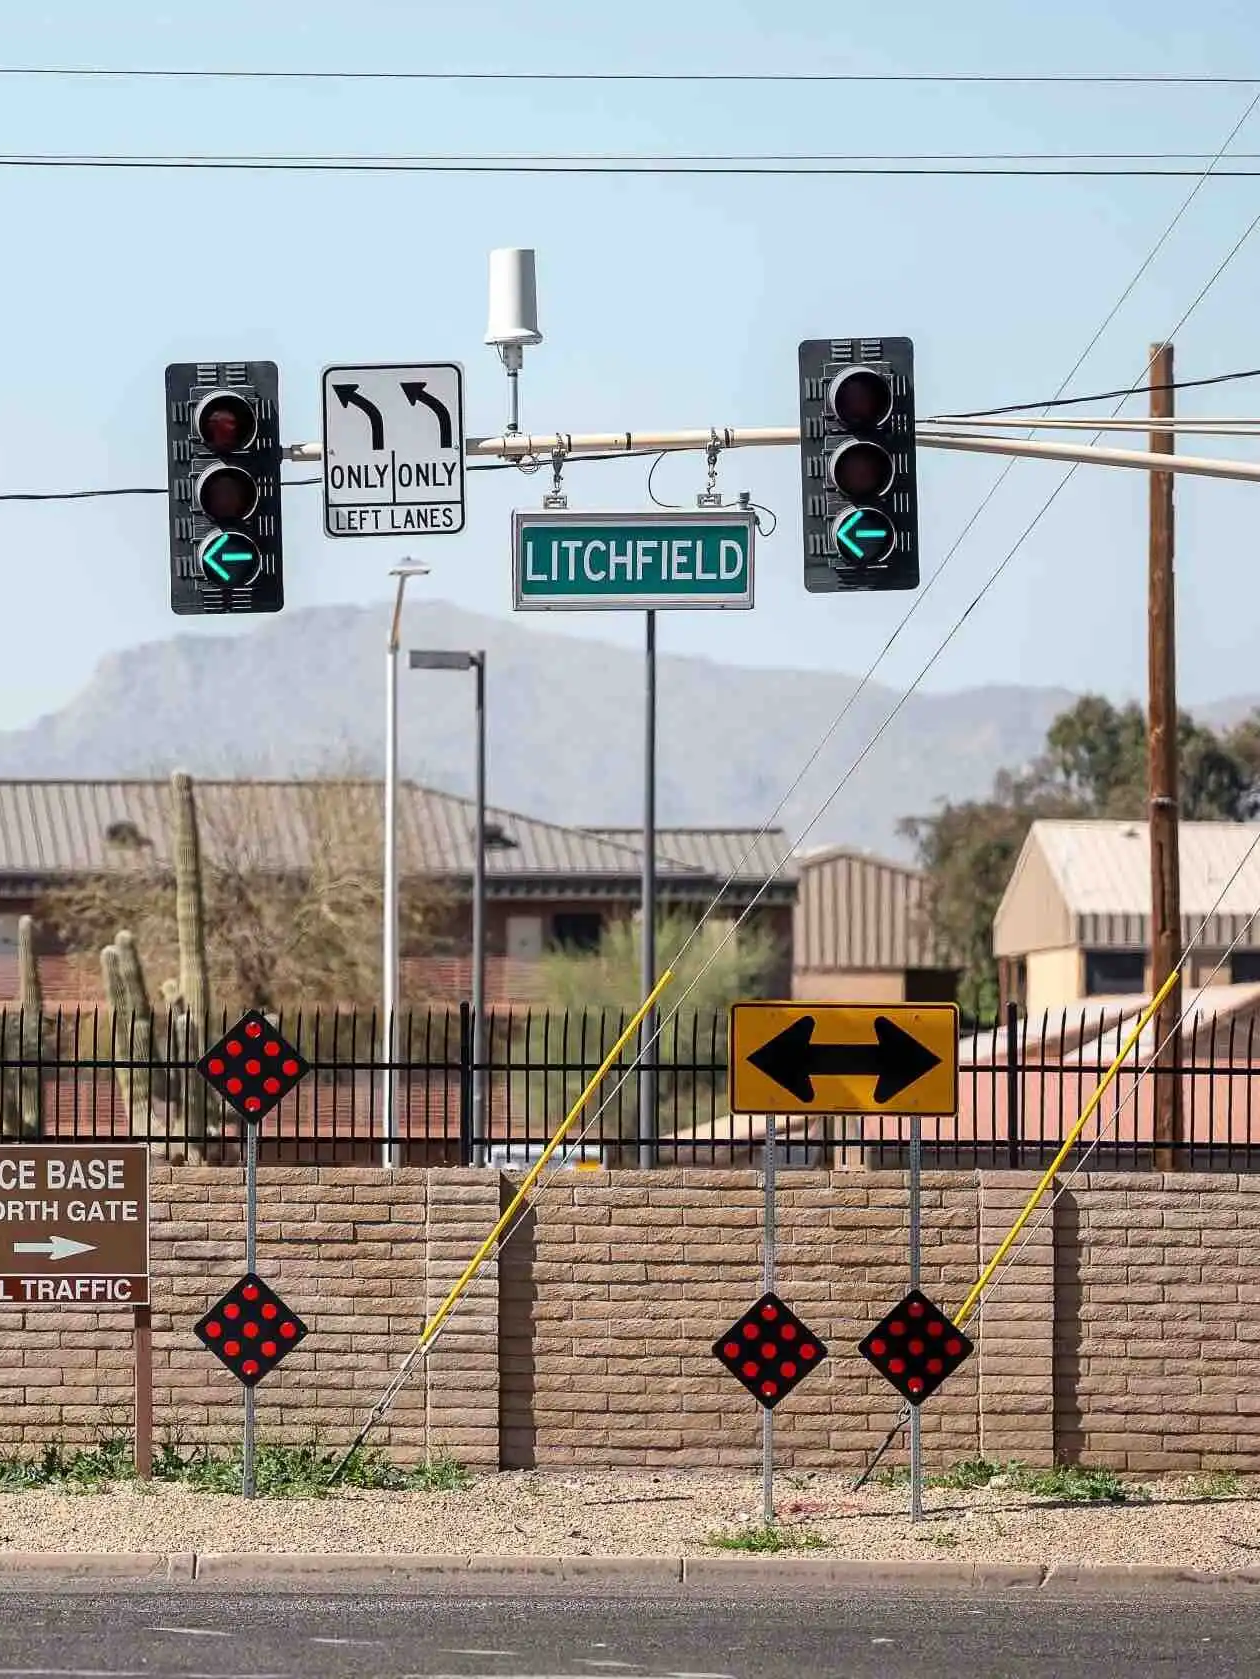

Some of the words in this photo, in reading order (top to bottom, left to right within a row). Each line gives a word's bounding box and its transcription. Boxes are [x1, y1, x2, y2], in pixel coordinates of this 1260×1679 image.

[331, 464, 388, 489] ONLY
[398, 462, 457, 487] ONLY
[335, 510, 380, 530] LEFT
[390, 508, 453, 529] LANES
[526, 539, 743, 581] LITCHFIELD
[47, 1159, 125, 1190] BASE
[67, 1200, 138, 1222] GATE
[21, 1279, 132, 1301] TRAFFIC
